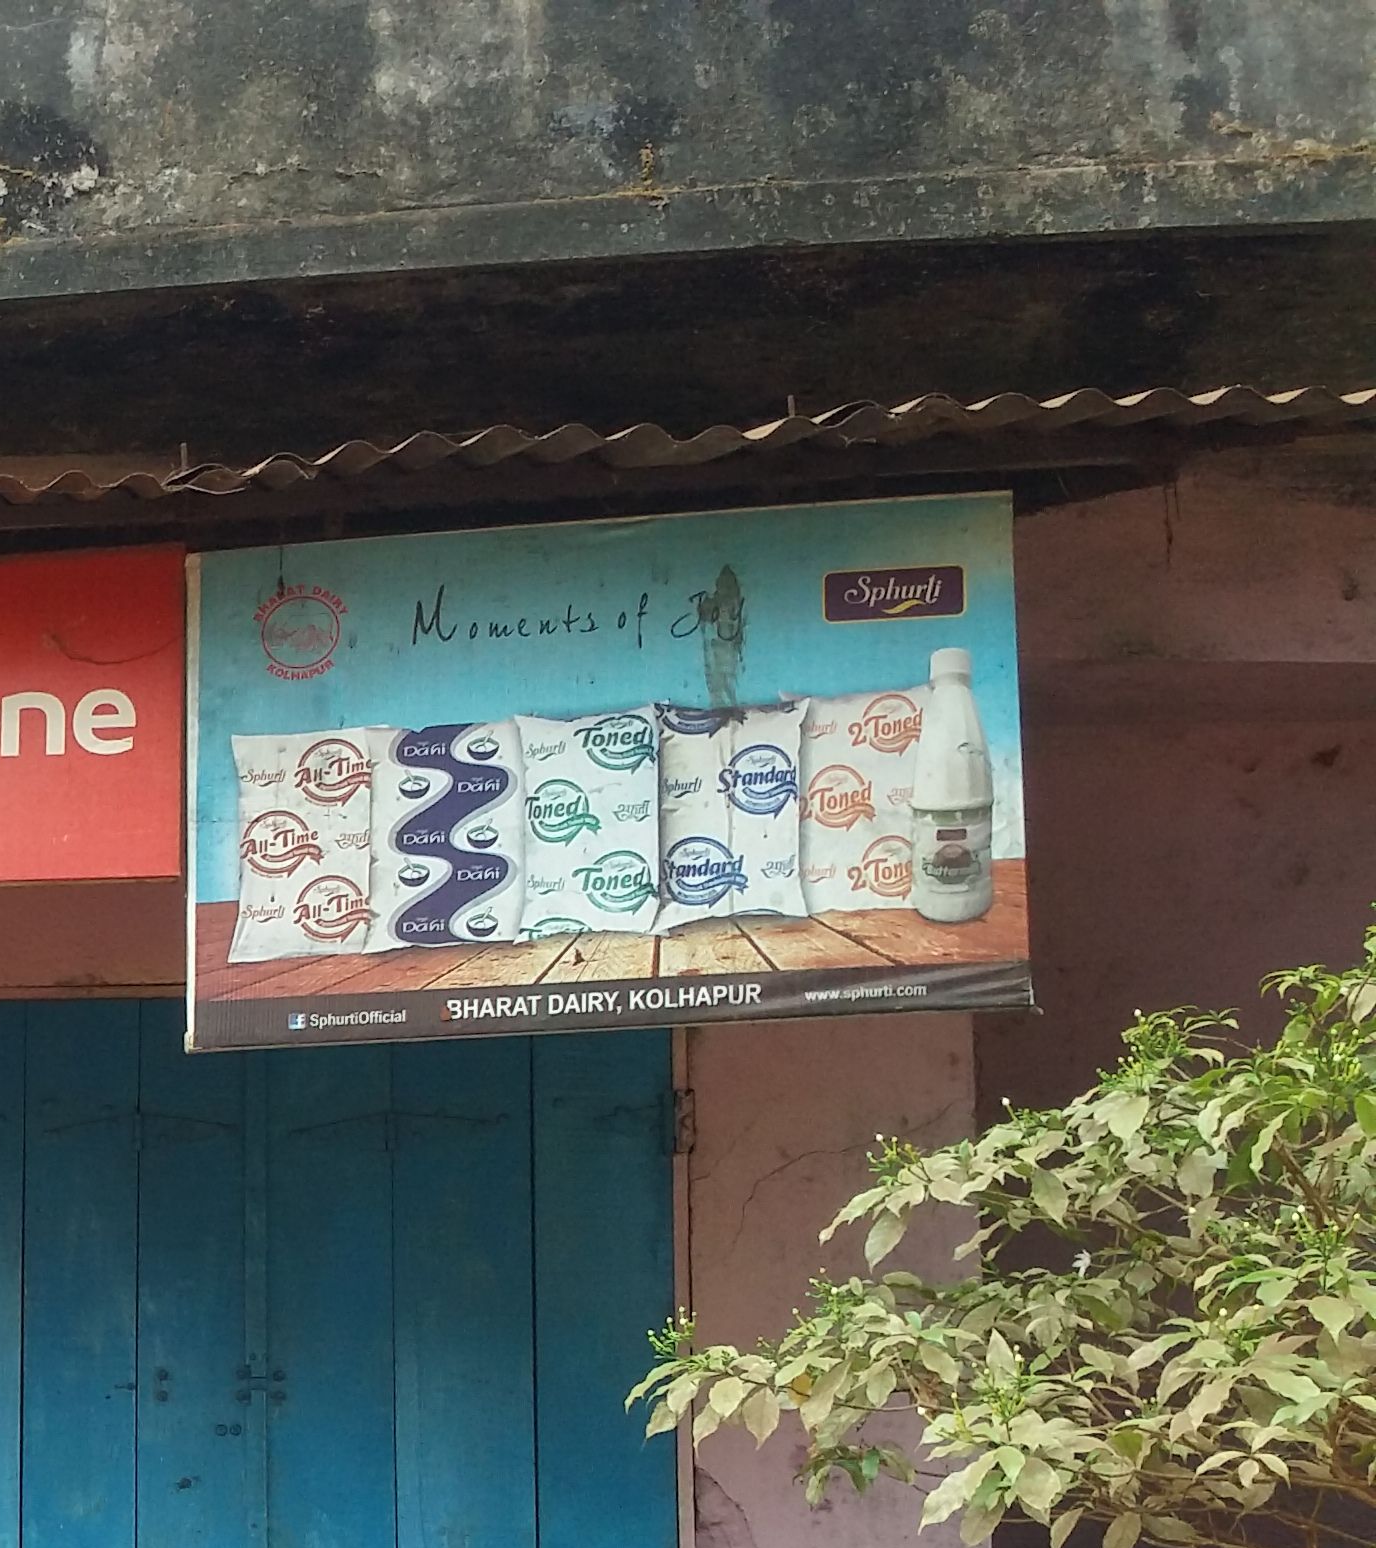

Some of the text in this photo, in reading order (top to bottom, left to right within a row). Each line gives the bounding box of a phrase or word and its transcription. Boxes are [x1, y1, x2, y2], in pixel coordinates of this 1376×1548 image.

[312, 586, 349, 615] DAIRY
[844, 574, 943, 608] Sphurti
[412, 585, 600, 646] Moments
[618, 592, 649, 649] of
[265, 657, 335, 681] KOLHAPUR
[573, 726, 648, 749] Toned
[848, 707, 923, 747] 2 Toned
[403, 744, 447, 757] Dahi
[241, 768, 286, 784] Sphurti
[457, 779, 501, 793] Dahi
[717, 765, 797, 794] Standard
[525, 795, 582, 820] Toned
[809, 780, 872, 813] Toned
[240, 827, 319, 860] All-Time
[403, 831, 445, 845] Dahi
[457, 867, 501, 881] Dahi
[572, 867, 647, 893] Toned
[848, 855, 912, 892] 2 Tone
[402, 919, 445, 933] Dahi
[447, 983, 763, 1022] BHARAT DAIRY, KOLHAPUR
[804, 981, 928, 1003] www.sphurti.com
[309, 1010, 407, 1029] SphurtiOfficial
